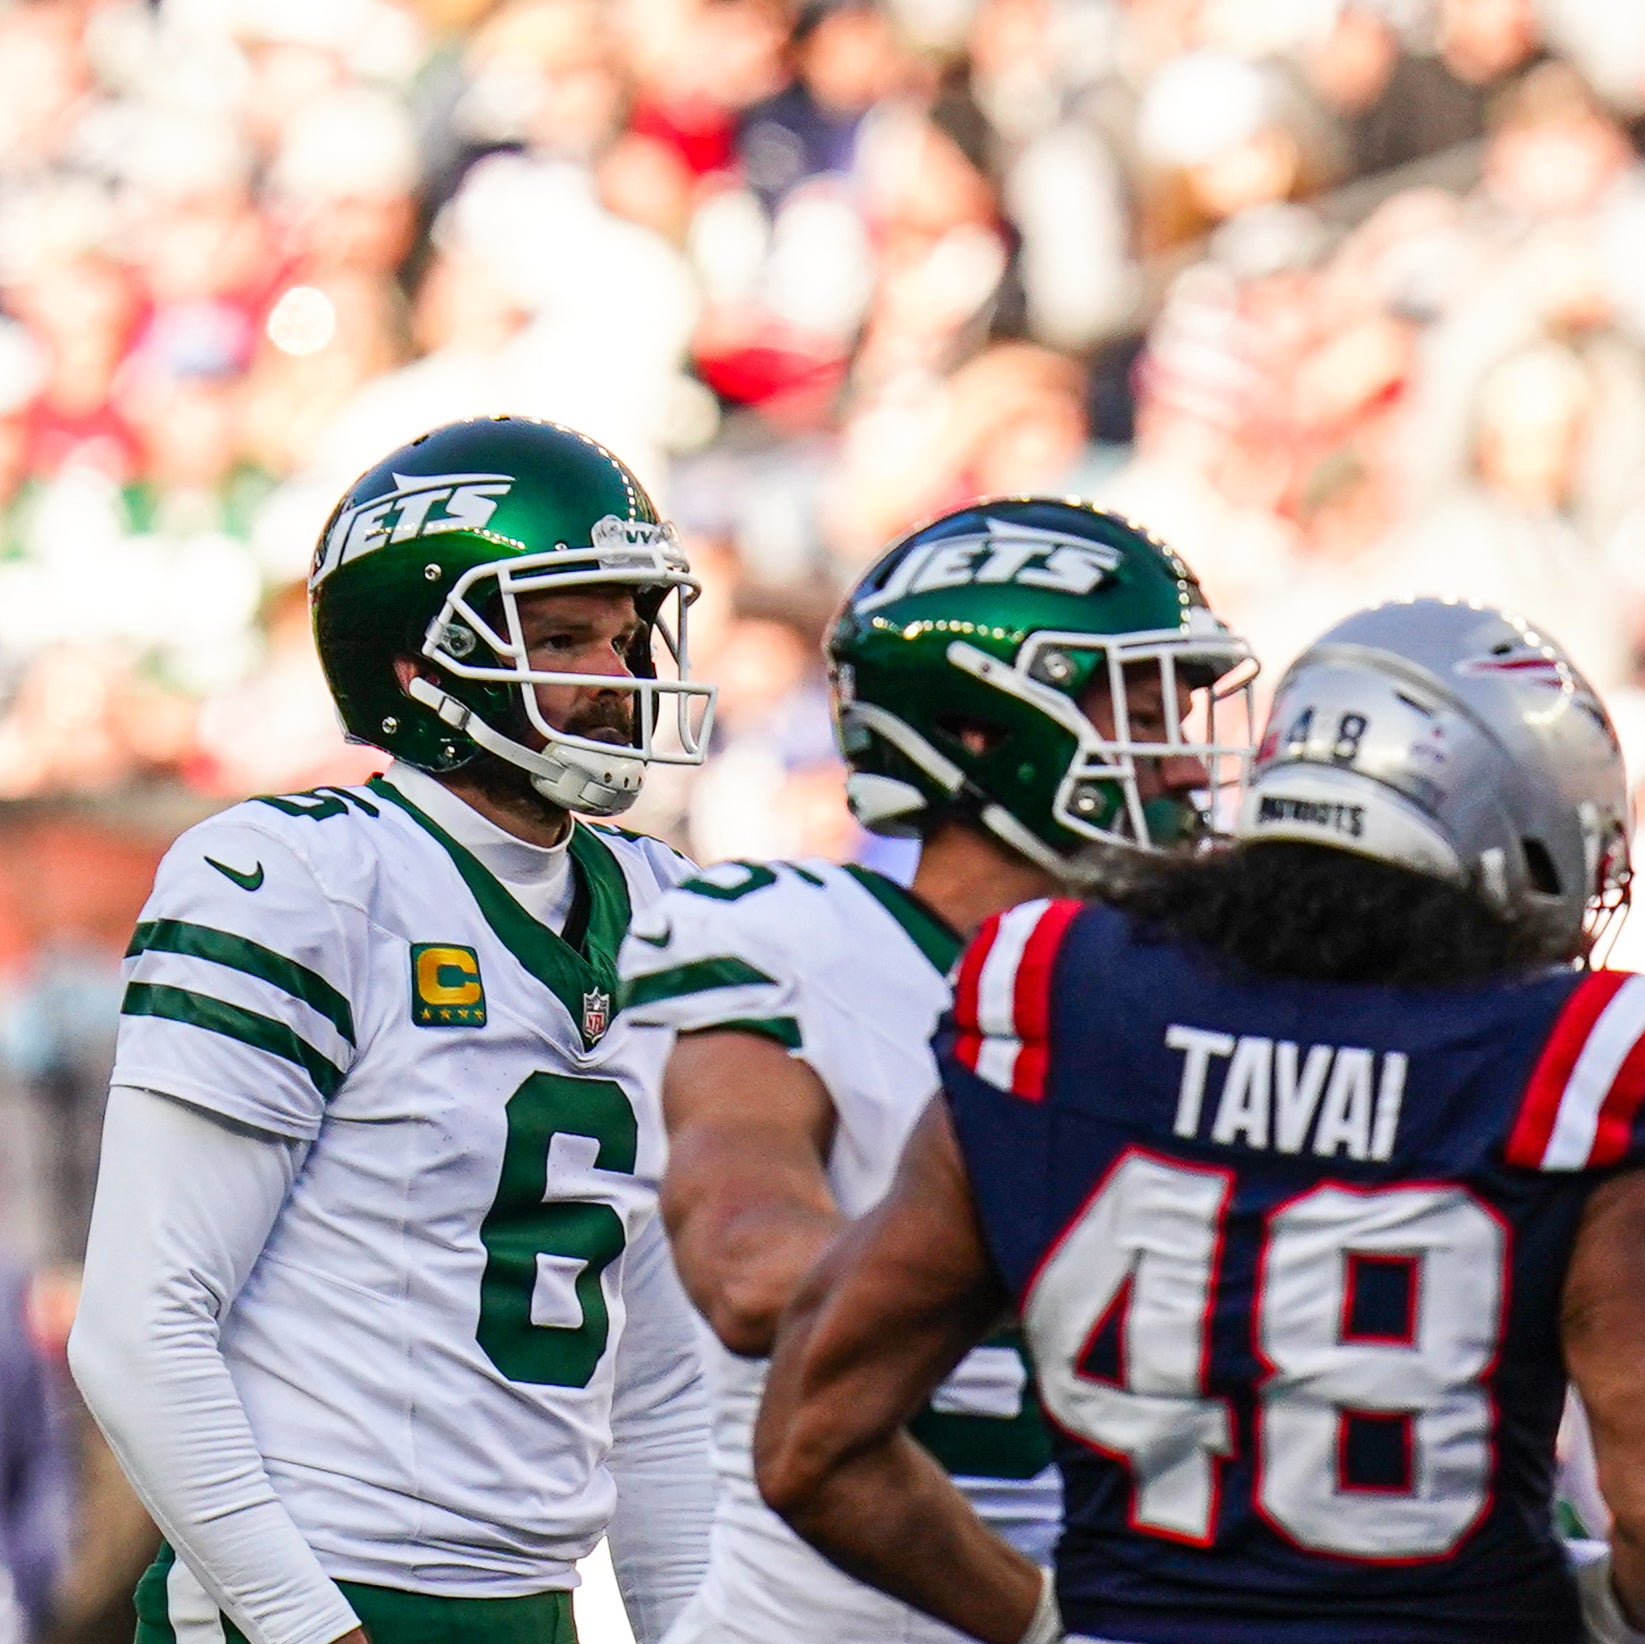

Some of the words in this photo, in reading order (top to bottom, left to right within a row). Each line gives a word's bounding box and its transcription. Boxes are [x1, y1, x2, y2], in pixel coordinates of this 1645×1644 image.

[308, 472, 516, 589] JETS
[853, 517, 1125, 615] JETS
[1287, 707, 1368, 762] 48
[417, 948, 481, 1006] C
[1165, 1022, 1409, 1162] TAVAI
[475, 1070, 638, 1389] 6
[1020, 1145, 1515, 1567] 48
